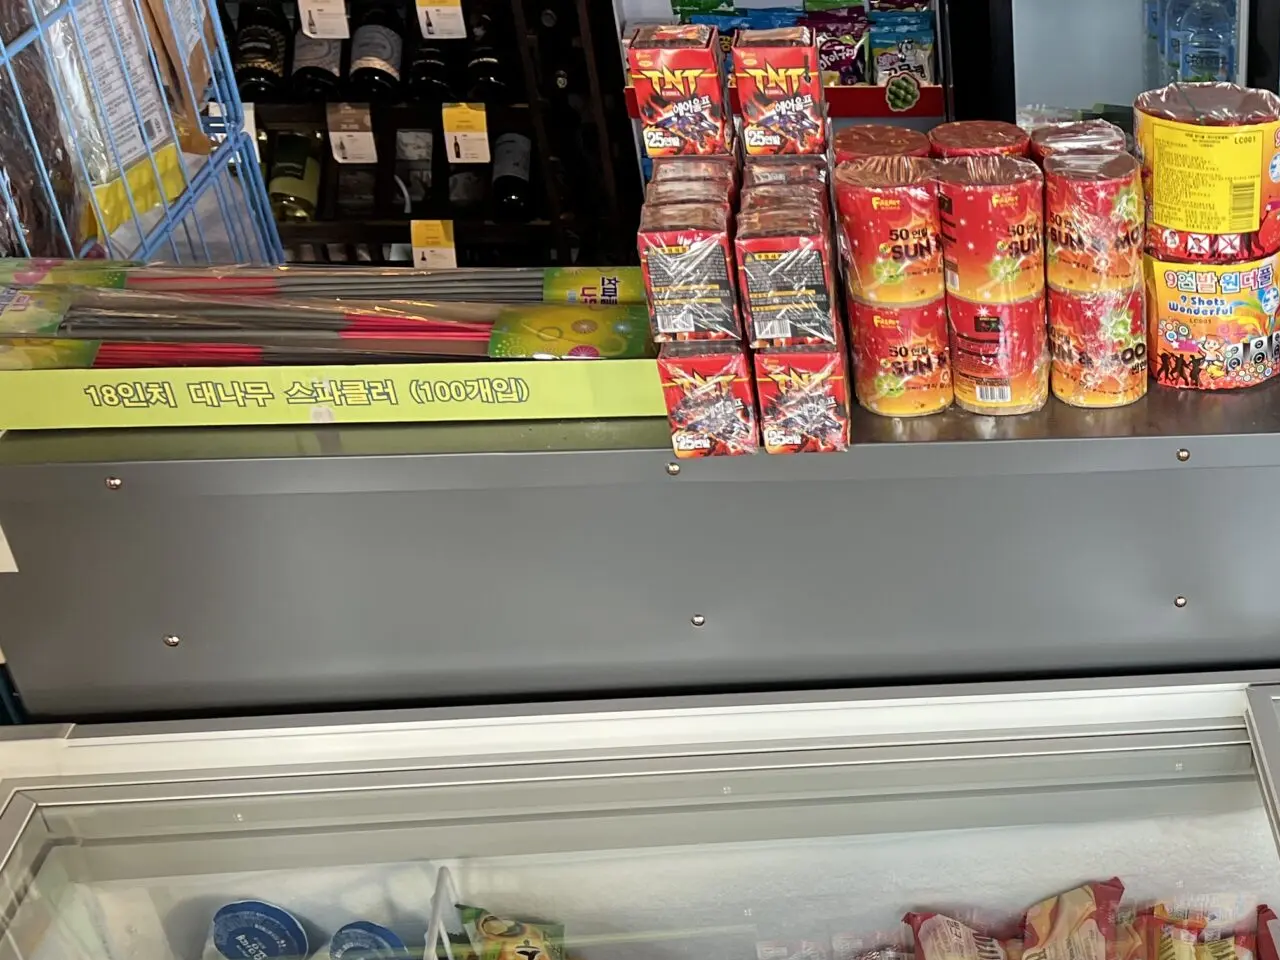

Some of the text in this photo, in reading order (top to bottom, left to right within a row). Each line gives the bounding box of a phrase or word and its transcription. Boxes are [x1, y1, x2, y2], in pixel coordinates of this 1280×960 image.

[640, 64, 704, 97] TNT
[745, 61, 807, 97] TNT
[1234, 135, 1256, 145] LC001
[890, 229, 909, 241] 50
[1164, 263, 1273, 294] 9연발 원더풀
[1168, 302, 1233, 316] Wonderful
[1180, 295, 1225, 306] 9 Shots
[84, 376, 530, 408] 18인치 대나무 스파클러 (100개입)
